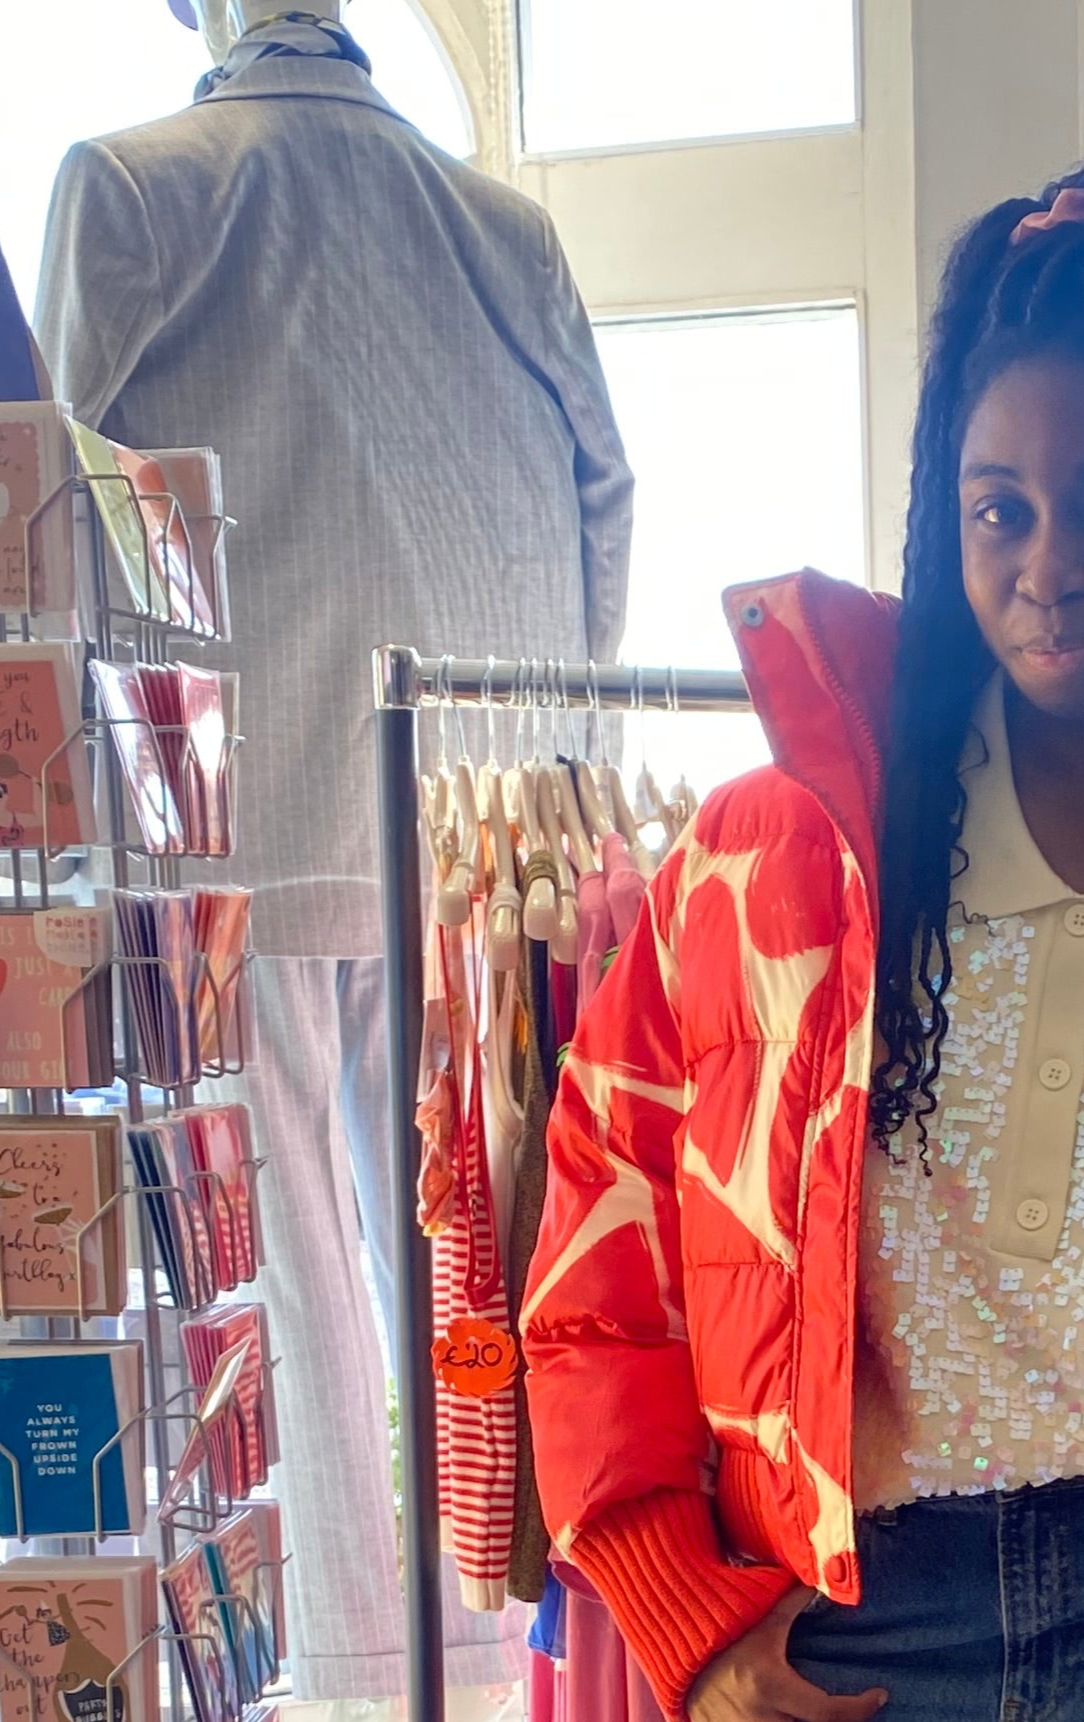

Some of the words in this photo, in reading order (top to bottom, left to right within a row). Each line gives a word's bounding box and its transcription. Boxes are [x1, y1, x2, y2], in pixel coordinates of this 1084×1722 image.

[0, 717, 40, 751] gth
[3, 1257, 65, 1293] irthday
[440, 1342, 503, 1369] £20
[36, 1403, 63, 1413] YOU
[27, 1416, 76, 1426] ALWAYS
[25, 1430, 58, 1439] TURN
[63, 1428, 80, 1437] MY
[31, 1441, 77, 1451] FROWN
[33, 1453, 78, 1464] UPSIDE
[38, 1466, 77, 1476] DOWN
